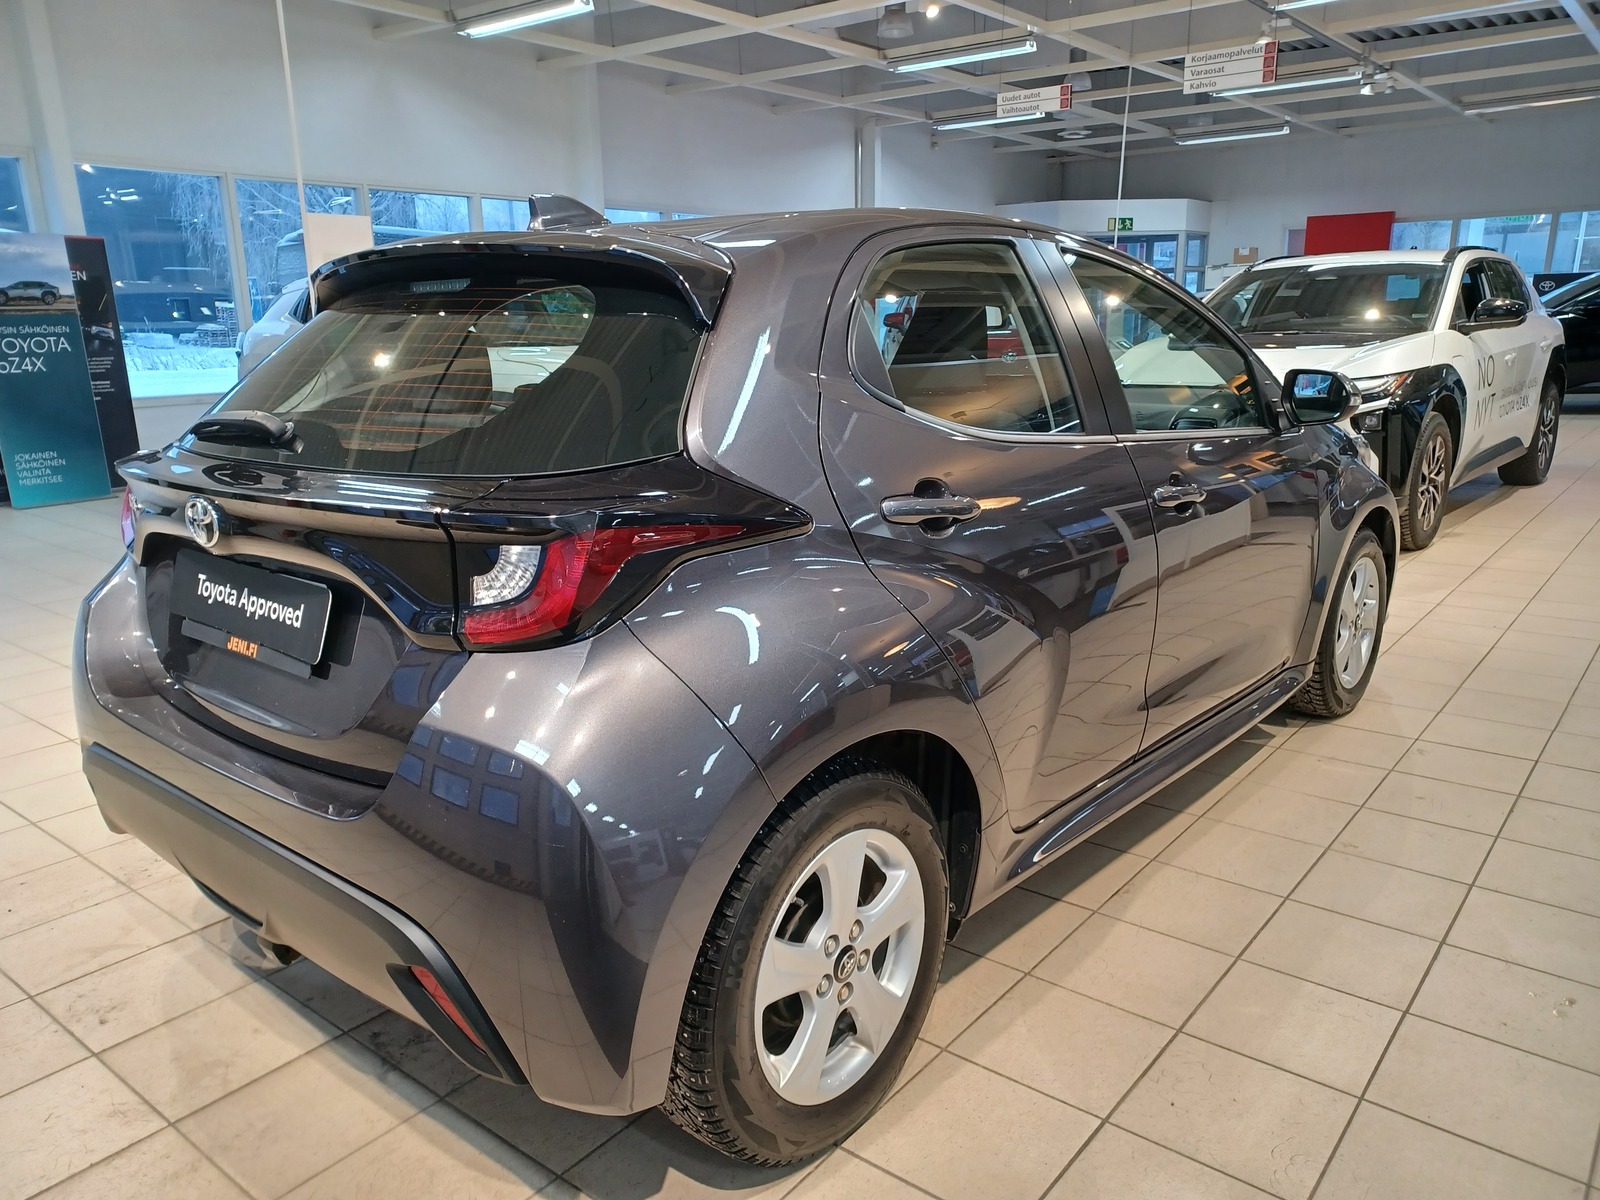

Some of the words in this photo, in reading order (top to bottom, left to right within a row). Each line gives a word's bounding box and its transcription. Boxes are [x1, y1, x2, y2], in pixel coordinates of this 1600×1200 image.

[1191, 45, 1263, 63] Korjaamopalvelut
[1190, 66, 1225, 77] Varaosat
[1189, 80, 1217, 90] Kahvio
[1002, 93, 1021, 103] Uudet
[1023, 91, 1041, 100] autot
[1001, 104, 1040, 115] Vaihtoautot
[19, 324, 70, 334] SÄHKÖINEN
[0, 336, 71, 354] OYOTA
[1478, 354, 1496, 391] NO
[14, 450, 57, 462] JOKAINEN
[15, 458, 66, 470] SÄHKÖINEN
[17, 467, 52, 478] VALINTA
[18, 475, 64, 486] MERKITSEE
[197, 573, 238, 605] Toyota
[238, 587, 305, 629] Approved
[227, 636, 259, 659] JENI.FI
